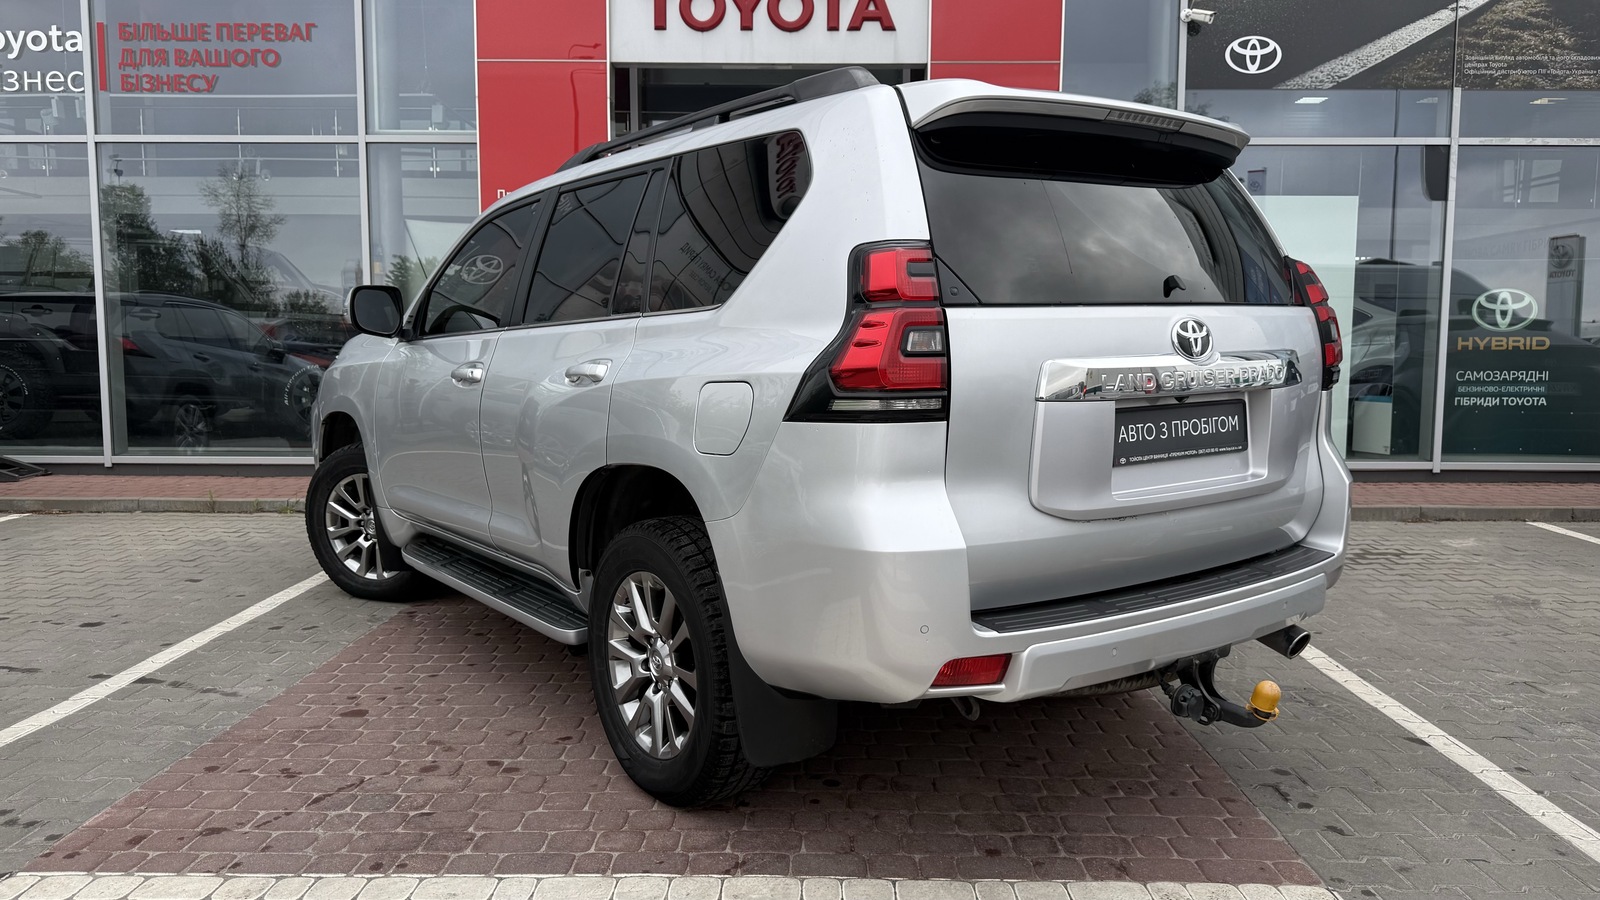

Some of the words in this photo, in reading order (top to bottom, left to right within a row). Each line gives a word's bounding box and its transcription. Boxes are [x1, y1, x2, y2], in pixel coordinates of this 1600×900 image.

[653, 0, 897, 32] TOYOTA
[0, 24, 83, 60] yota
[117, 22, 208, 41] БІЛЬШЕ
[215, 22, 317, 42] ПЕРЕВАГ
[118, 48, 168, 70] ДЛЯ
[174, 48, 280, 67] ВАШОГО
[120, 73, 218, 92] БІЗНЕСУ
[1457, 336, 1550, 351] HYBRID
[1101, 373, 1157, 393] LAND
[1161, 369, 1236, 391] CRUISER
[1239, 364, 1287, 384] PRADO
[1455, 370, 1549, 383] САМОЗАРЯДНІ
[1457, 385, 1545, 393] БЕНЗИНОВО-ЕЛЕКТРИЧНІ
[1454, 397, 1500, 407] ГІБРИДИ
[1502, 397, 1547, 406] TOYOTA
[1118, 422, 1156, 443] АВТО
[1171, 414, 1239, 438] ПРОБІГОМ
